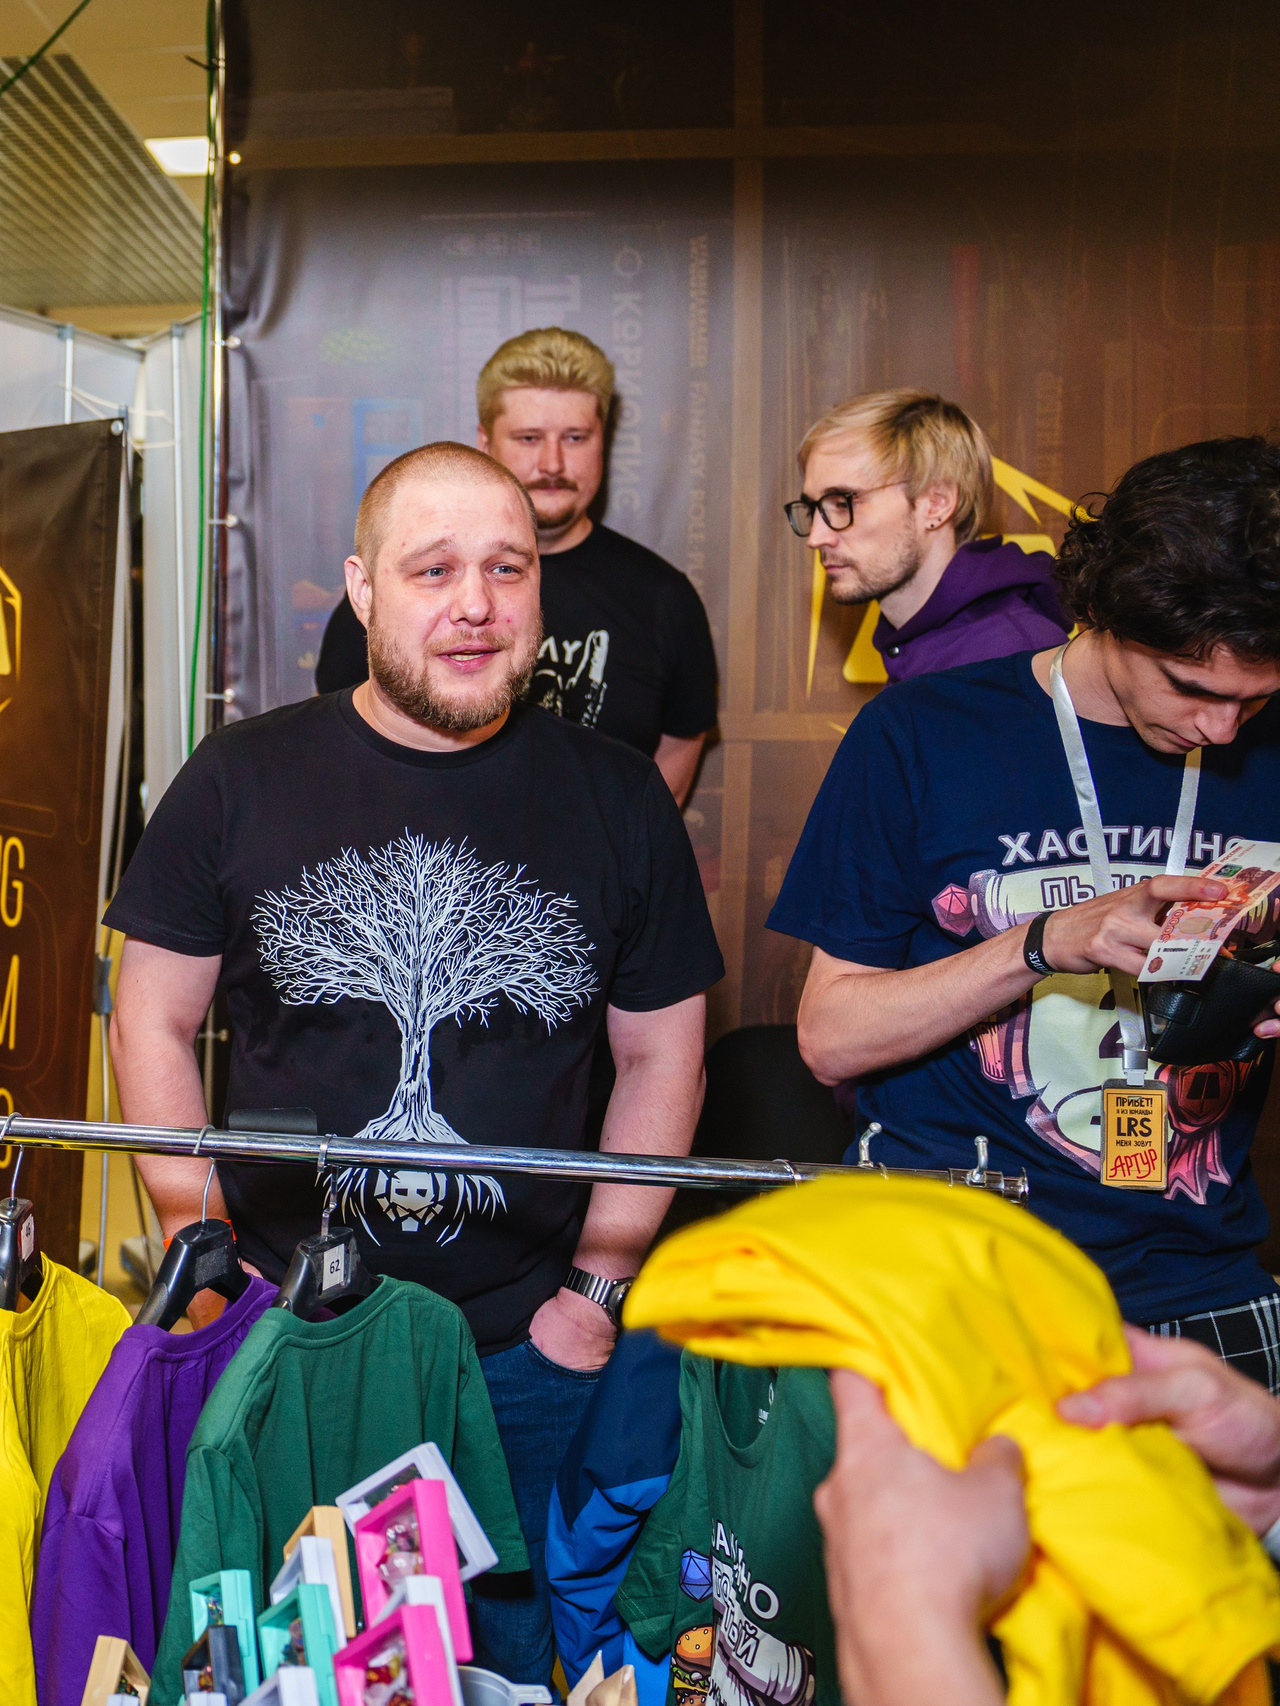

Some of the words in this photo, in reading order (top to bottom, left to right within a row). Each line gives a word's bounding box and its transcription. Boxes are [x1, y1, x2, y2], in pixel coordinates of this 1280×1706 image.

[1116, 1096, 1153, 1108] ПРИВЕТ!
[1116, 1117, 1152, 1137] LRS
[1109, 1148, 1158, 1179] АРТУР
[329, 1258, 341, 1275] 62
